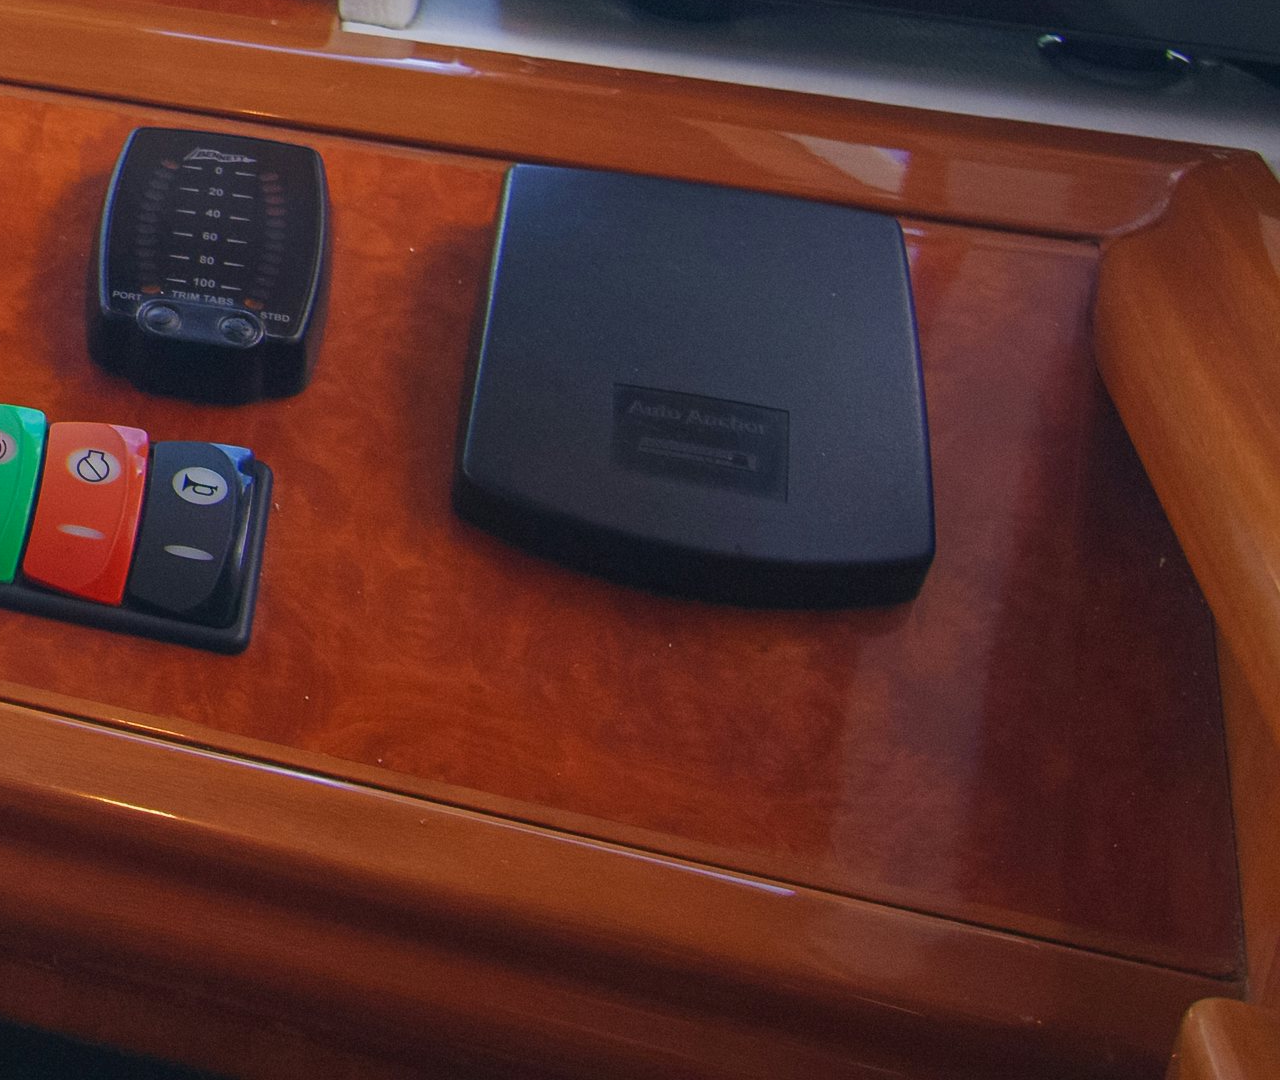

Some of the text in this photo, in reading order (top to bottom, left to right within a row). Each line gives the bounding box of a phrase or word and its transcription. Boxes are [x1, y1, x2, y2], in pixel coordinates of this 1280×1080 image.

[215, 167, 223, 175] 0
[208, 187, 224, 197] 20
[205, 209, 221, 219] 40
[202, 231, 218, 242] 60
[199, 255, 215, 265] 80
[192, 277, 216, 289] 100
[112, 289, 142, 301] PORT
[171, 290, 234, 306] TRIM TABS
[260, 311, 290, 323] STBD
